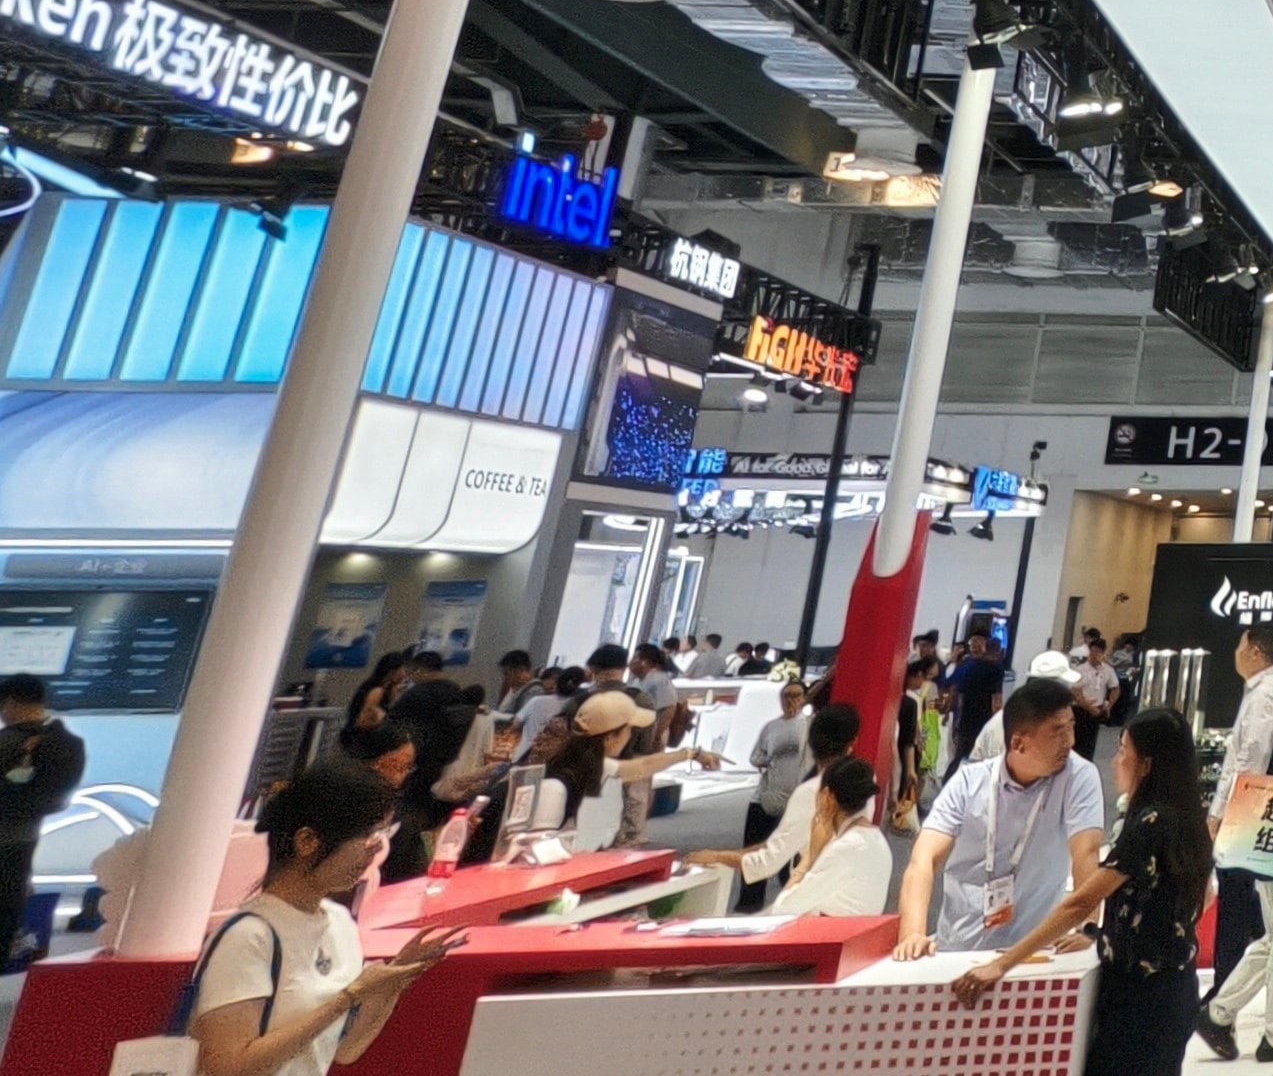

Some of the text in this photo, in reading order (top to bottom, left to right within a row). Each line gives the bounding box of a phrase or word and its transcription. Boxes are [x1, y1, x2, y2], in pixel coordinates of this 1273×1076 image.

[504, 152, 617, 247] intel
[1167, 425, 1268, 459] H2-
[465, 469, 515, 492] COFFEE
